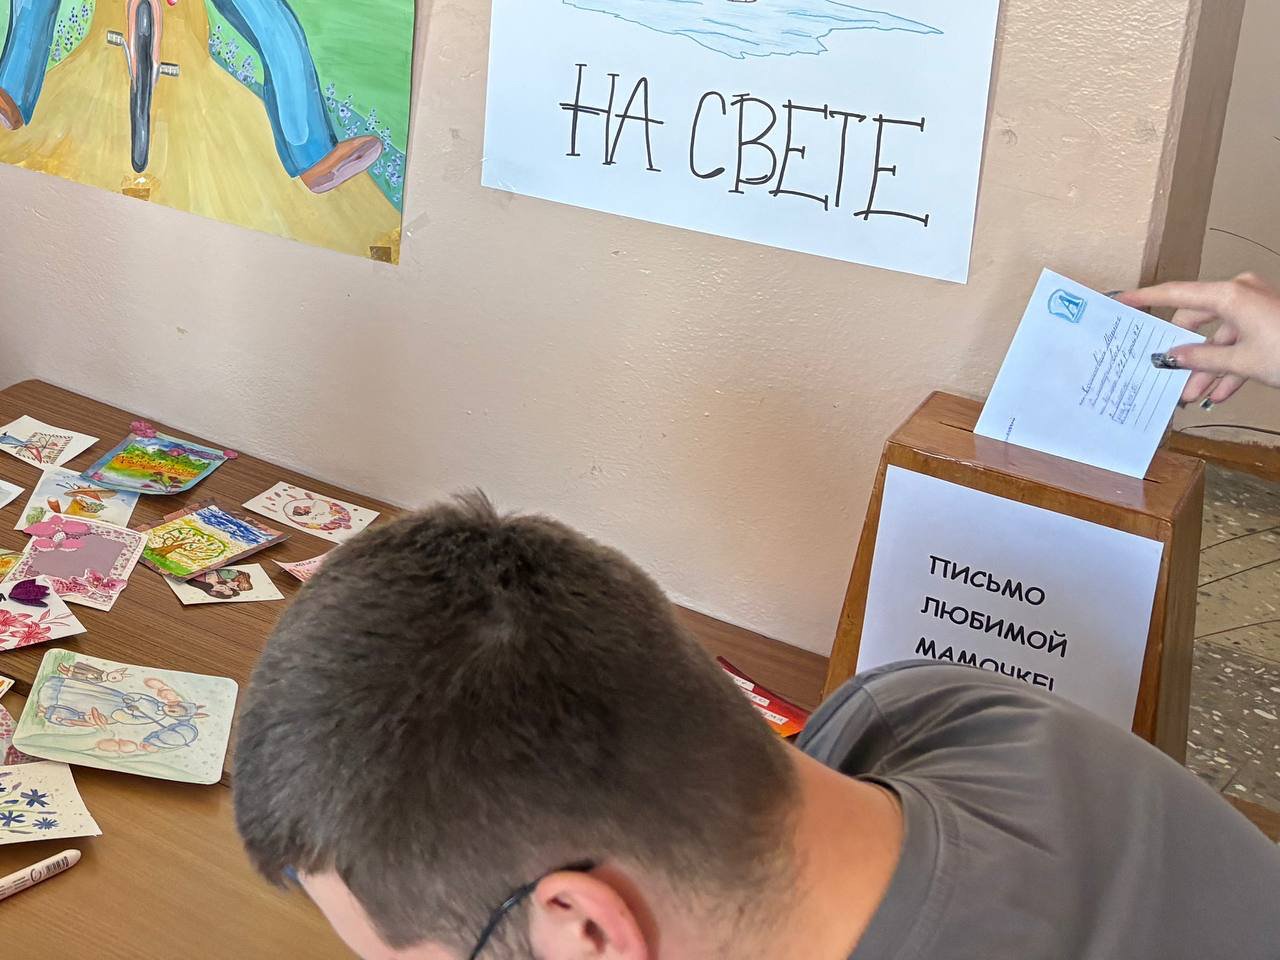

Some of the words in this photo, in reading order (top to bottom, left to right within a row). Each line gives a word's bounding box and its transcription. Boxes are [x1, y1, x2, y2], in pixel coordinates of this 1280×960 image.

[559, 63, 664, 173] НА
[689, 90, 930, 227] СВЕТЕ
[929, 555, 1045, 606] ПИСЬМО
[920, 596, 1068, 658] ЛЮБИМОЙ
